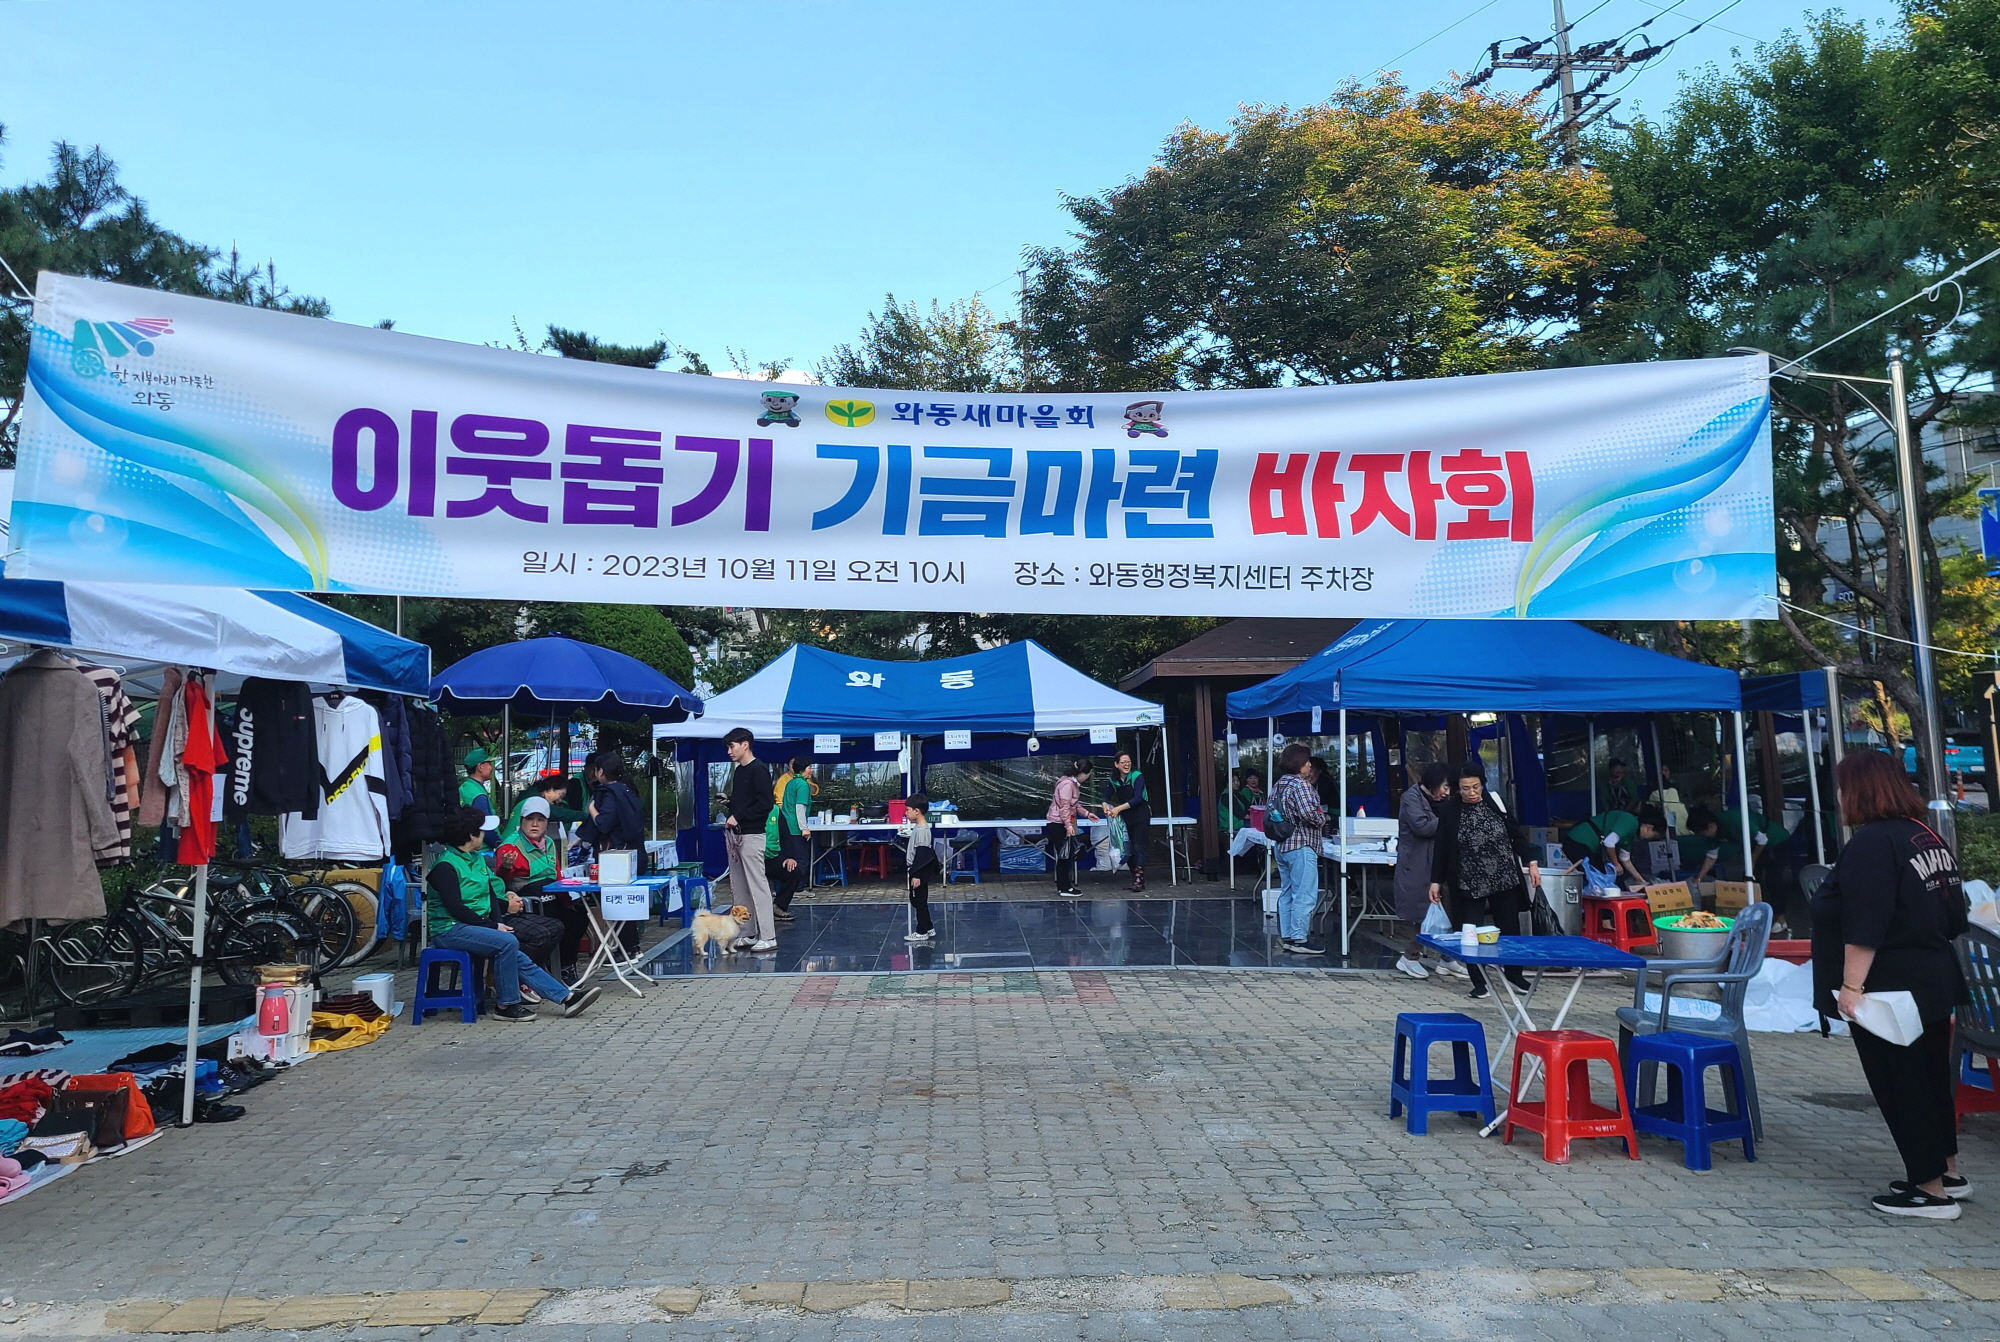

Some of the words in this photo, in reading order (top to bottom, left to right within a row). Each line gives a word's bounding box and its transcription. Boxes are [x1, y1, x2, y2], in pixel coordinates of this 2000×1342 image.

[110, 364, 129, 384] 한
[131, 391, 176, 411] 와동
[891, 402, 1096, 429] 와동새마을회
[331, 407, 774, 533] 이웃돕기
[811, 444, 1220, 539] 기금마련
[1248, 448, 1535, 542] 바자회
[522, 551, 577, 575] 일시
[602, 554, 707, 579] 2023년
[717, 556, 776, 581] 10월
[785, 558, 838, 582] 11일
[846, 559, 899, 584] 오전
[907, 561, 966, 585] 10시
[1013, 561, 1066, 586] 장소
[1088, 562, 1292, 592] 와동행정복지센터
[1299, 566, 1376, 592] 주차장
[846, 670, 887, 689] 와
[939, 669, 976, 690] 동
[605, 894, 623, 905] 티켓
[626, 894, 645, 905] 판매
